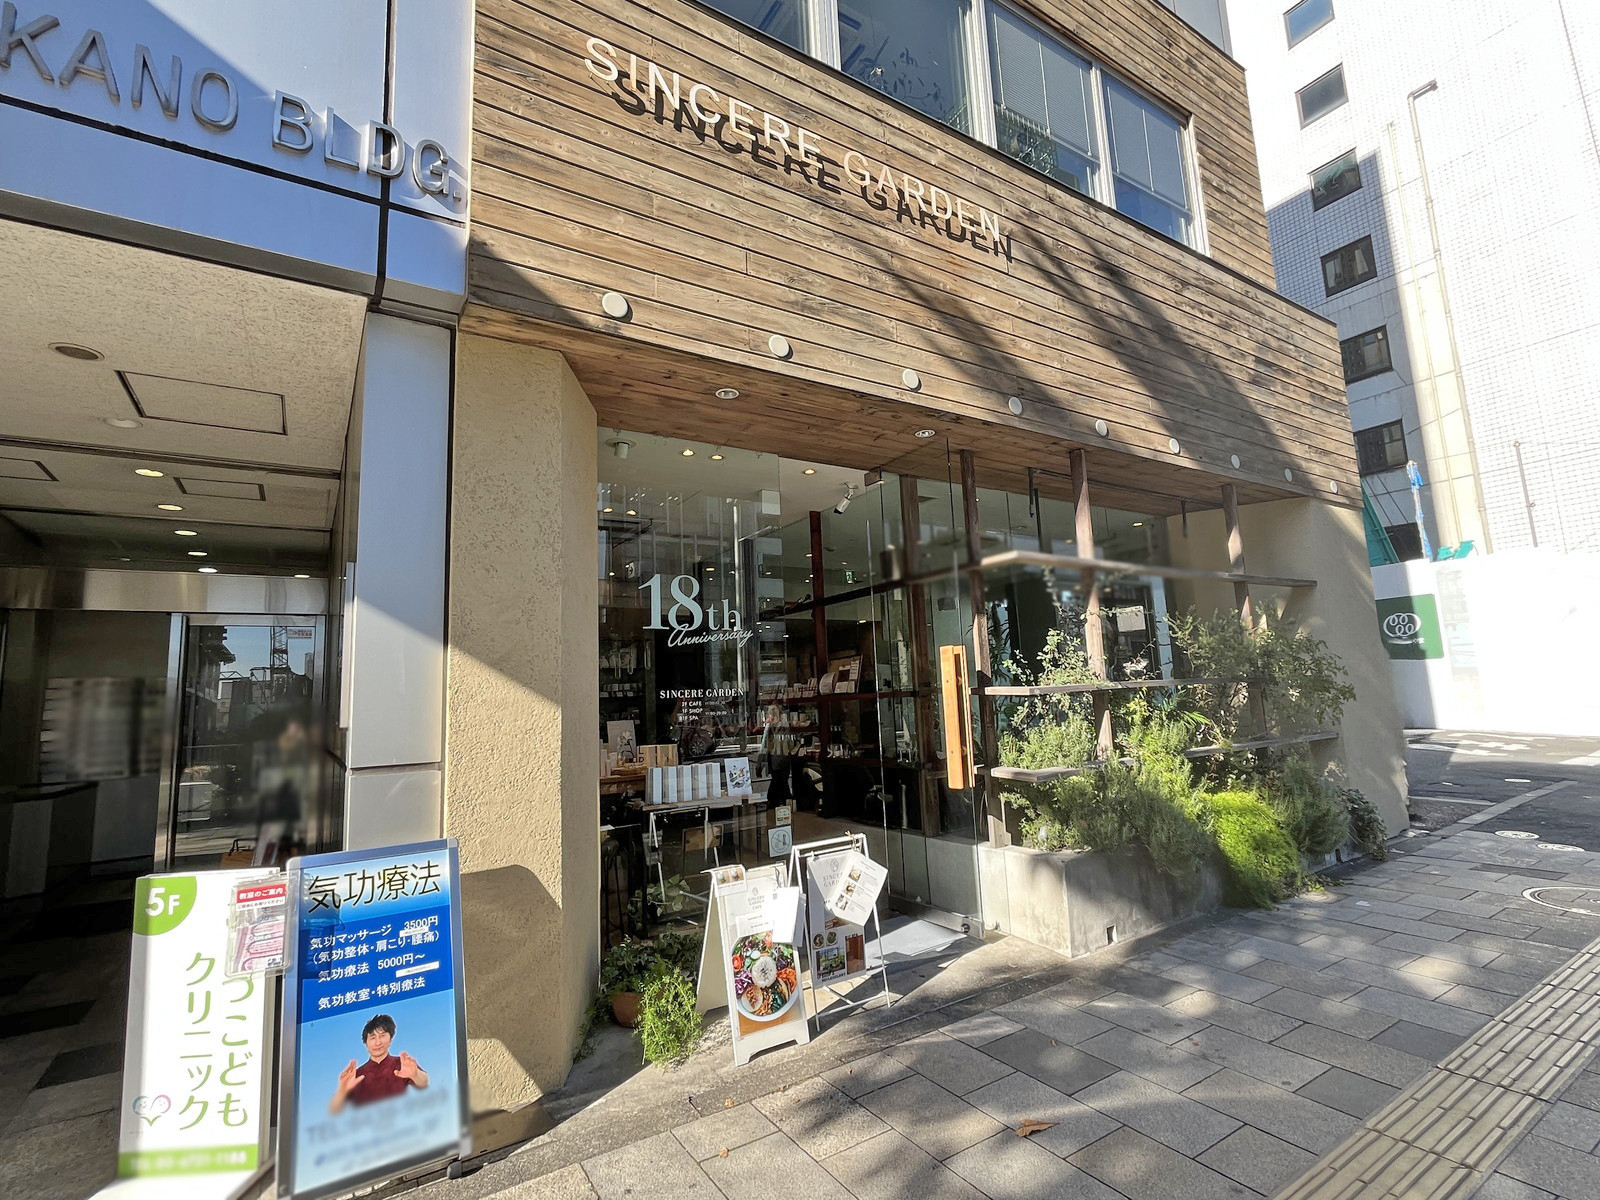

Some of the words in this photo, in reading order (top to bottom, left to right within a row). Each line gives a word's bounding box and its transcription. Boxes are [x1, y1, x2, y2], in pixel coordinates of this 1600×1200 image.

[0, 0, 239, 133] KANO
[272, 89, 462, 202] BLDG.
[584, 37, 824, 169] SINCERE
[843, 150, 1002, 242] GARDEN
[638, 573, 743, 631] 18th
[667, 623, 754, 648] Anniversary
[659, 689, 704, 699] SINCERE
[705, 688, 745, 698] GARDEN
[145, 887, 181, 917] 5F
[308, 859, 441, 914] 気功療法
[309, 923, 392, 950] 気功マッサージ
[403, 915, 439, 930] 3500円
[317, 961, 370, 983] 気功療法
[317, 975, 426, 1011] 気功教室・特別療法
[178, 952, 217, 1131] クリニック
